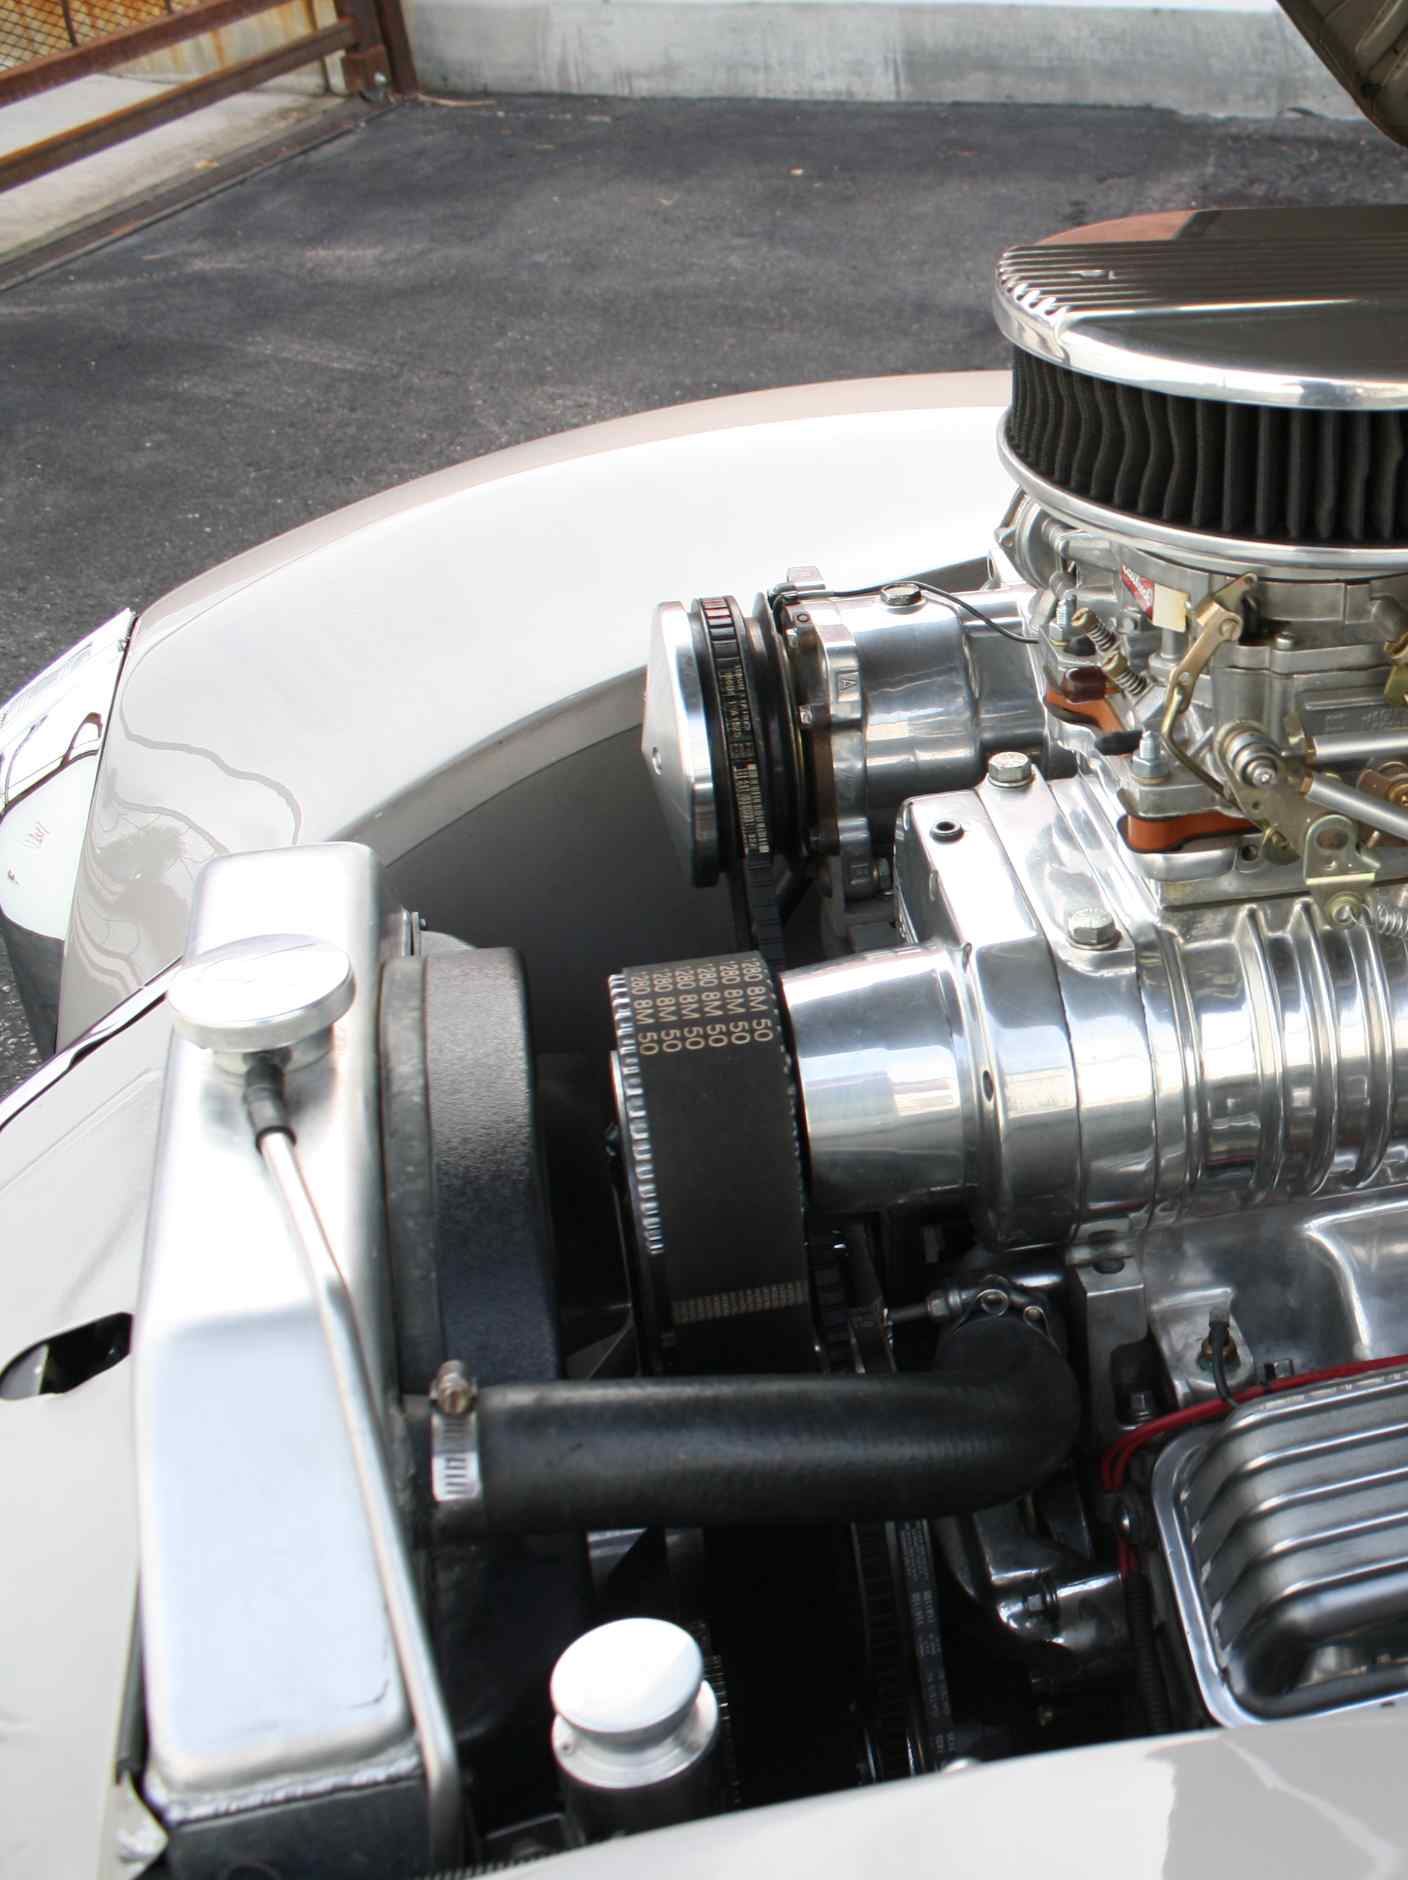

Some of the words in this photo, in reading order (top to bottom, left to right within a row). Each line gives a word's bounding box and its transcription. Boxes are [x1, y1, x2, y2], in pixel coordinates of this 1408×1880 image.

[656, 996, 679, 1022] 8M
[679, 993, 702, 1020] 8M
[702, 991, 724, 1017] 8M
[724, 988, 747, 1015] 8M
[747, 985, 769, 1012] 8M
[633, 999, 656, 1025] 8M
[661, 1029, 683, 1053] 50
[684, 1026, 705, 1050] 50
[706, 1023, 728, 1048] 50
[729, 1021, 751, 1045] 50
[752, 1018, 774, 1042] 50
[638, 1031, 659, 1056] 50
